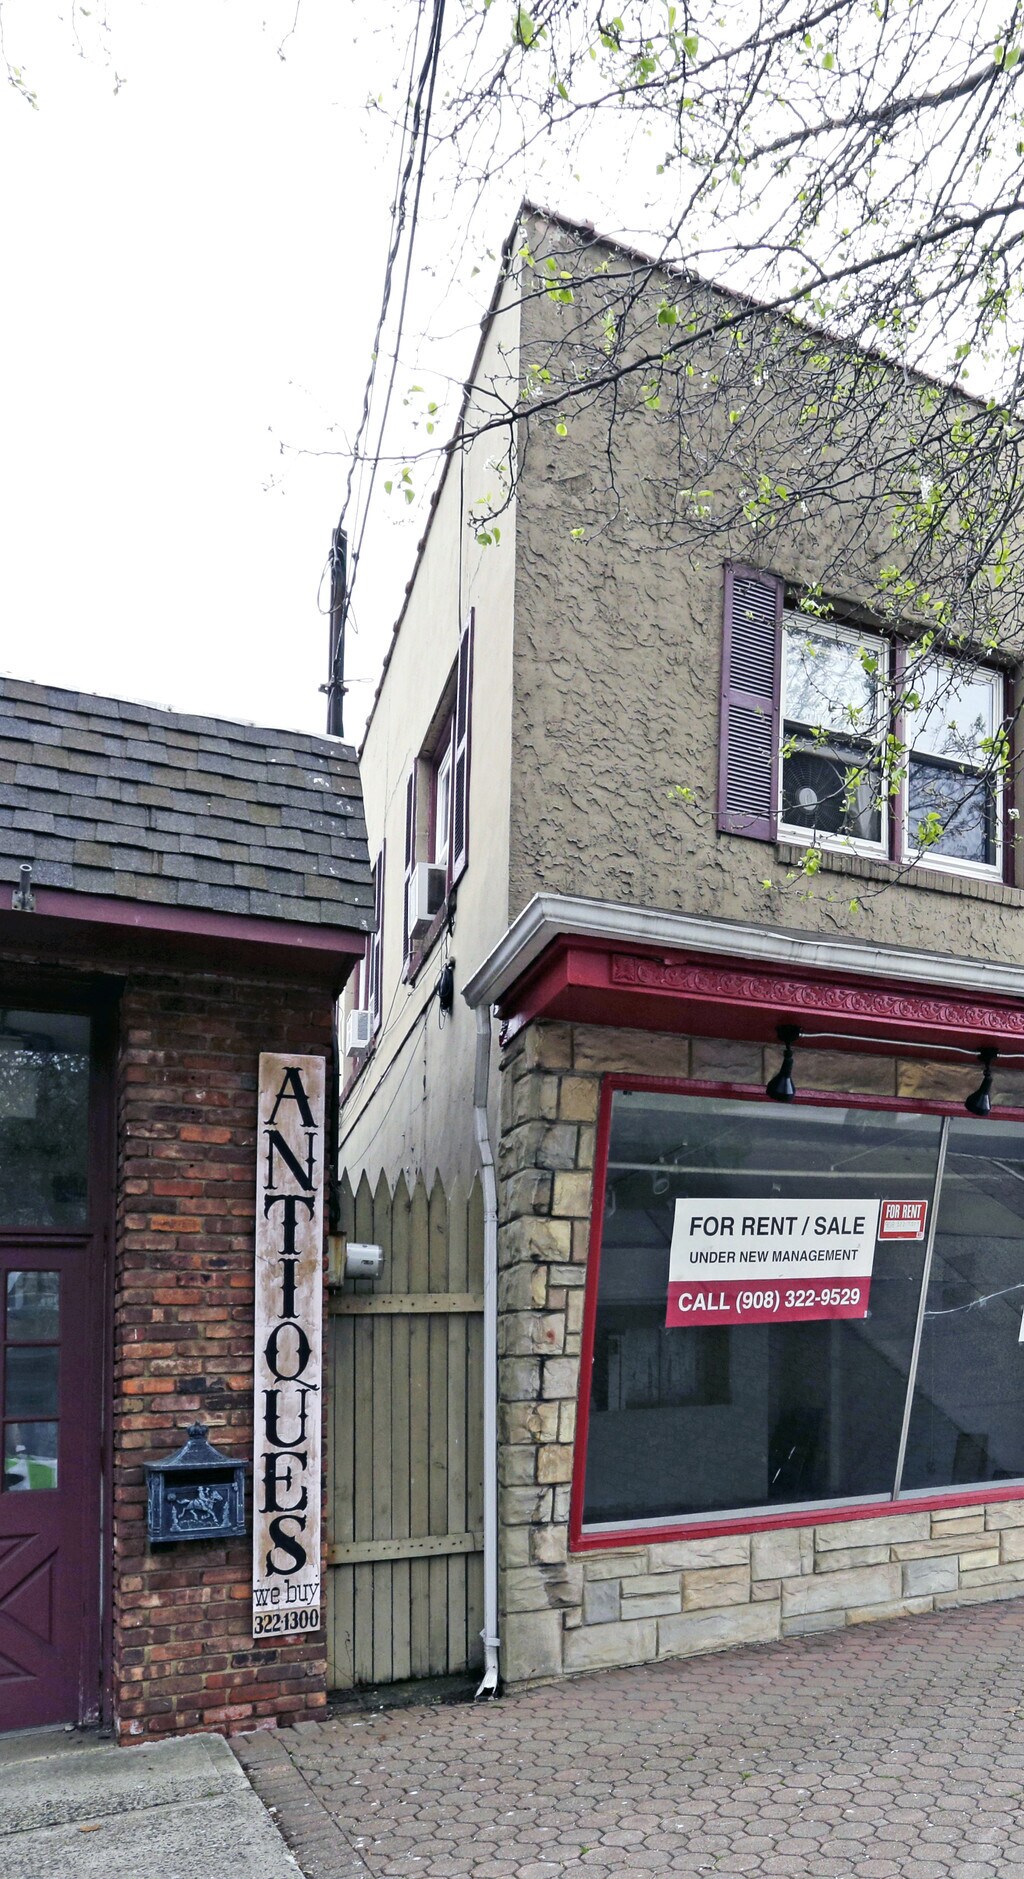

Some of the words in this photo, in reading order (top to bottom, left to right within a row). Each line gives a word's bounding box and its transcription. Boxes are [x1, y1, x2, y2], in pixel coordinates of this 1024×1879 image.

[886, 1204, 900, 1218] FOR
[902, 1204, 922, 1218] RENT
[689, 1216, 734, 1236] FOR
[741, 1216, 797, 1236] RENT
[814, 1216, 866, 1235] SALE
[689, 1251, 735, 1263] UNDER
[739, 1250, 769, 1263] NEW
[772, 1249, 858, 1262] MANAGEMENT
[678, 1292, 730, 1311] CALL
[735, 1290, 780, 1313] (908)
[784, 1288, 861, 1307] 322-9529
[258, 1066, 320, 1577] ANTIQUES
[253, 1586, 280, 1607] we
[284, 1579, 320, 1606] buy
